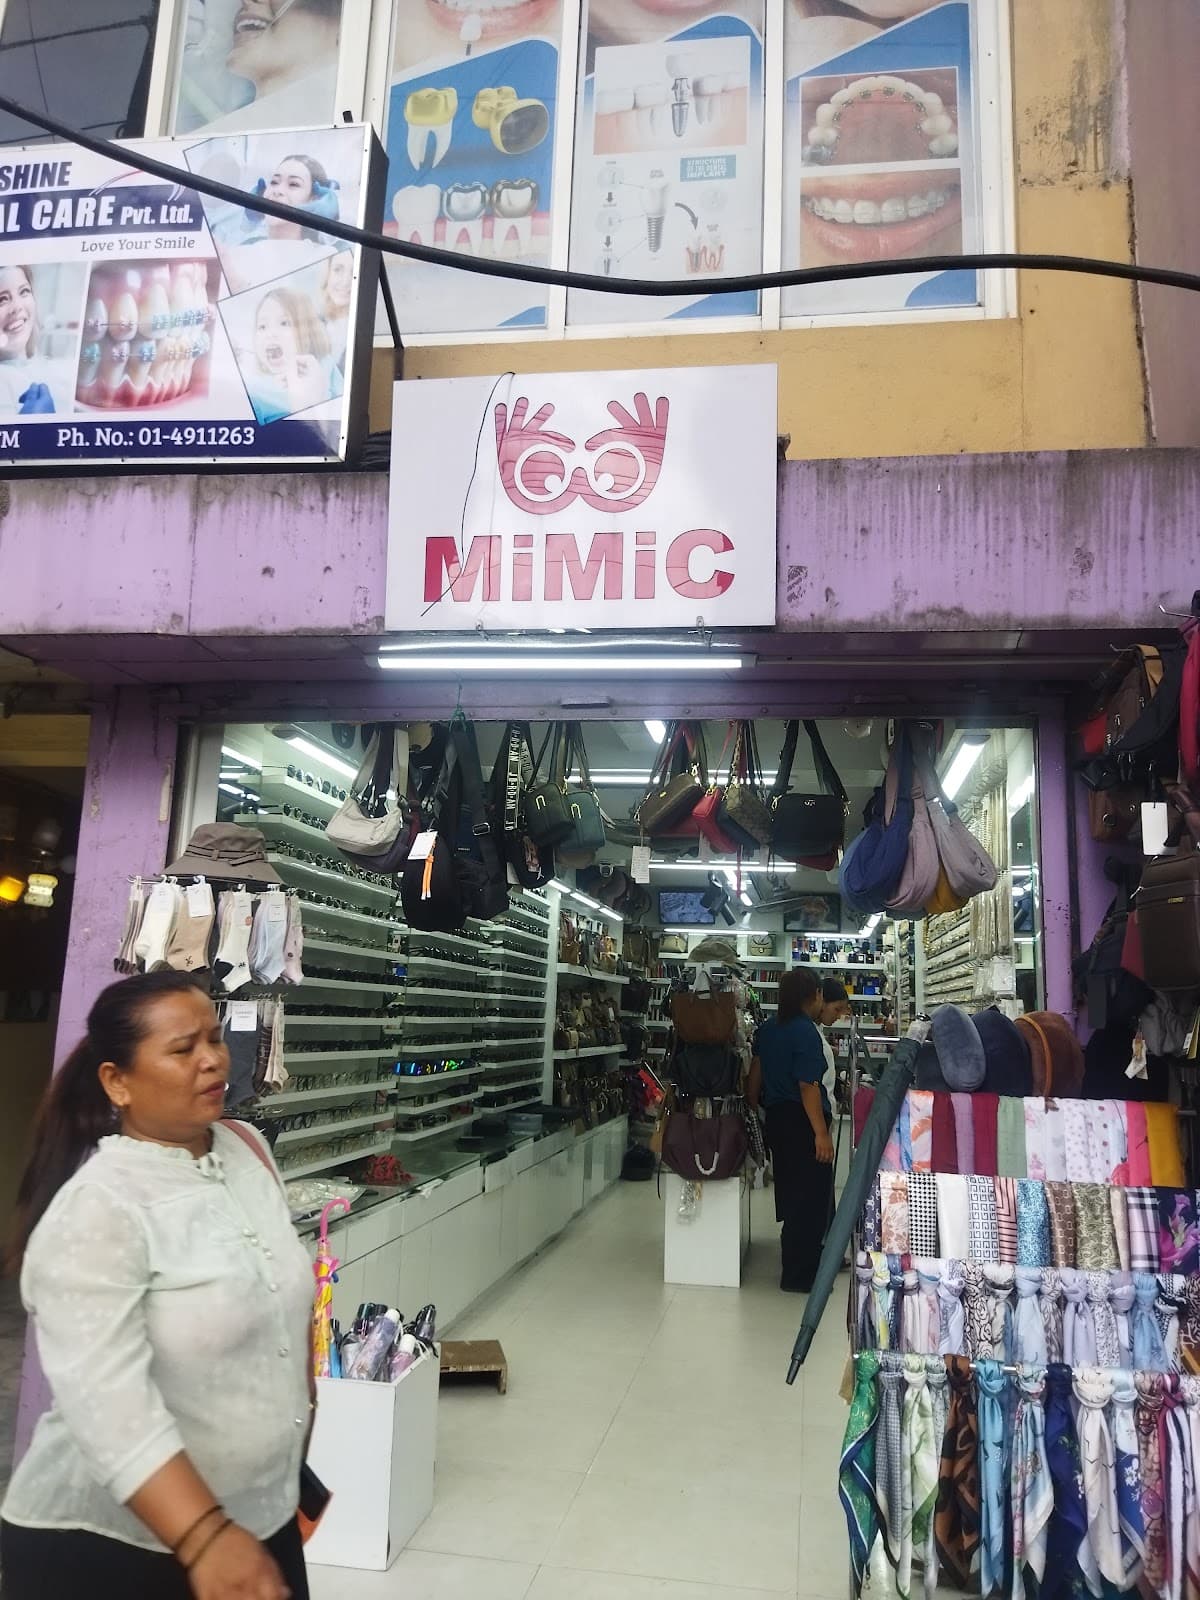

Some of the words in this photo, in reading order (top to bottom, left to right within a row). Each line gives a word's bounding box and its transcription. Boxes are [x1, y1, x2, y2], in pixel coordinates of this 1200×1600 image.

[0, 161, 72, 191] SHINE
[0, 202, 20, 233] L
[31, 196, 115, 231] CARE
[120, 206, 156, 226] Pvt.
[160, 204, 193, 224] Ltd.
[81, 240, 114, 252] Love
[118, 239, 152, 250] Your
[154, 236, 195, 249] Smile
[0, 430, 20, 448] M
[57, 427, 90, 447] Ph.
[95, 427, 134, 446] No.:
[138, 426, 255, 446] 01-4911263
